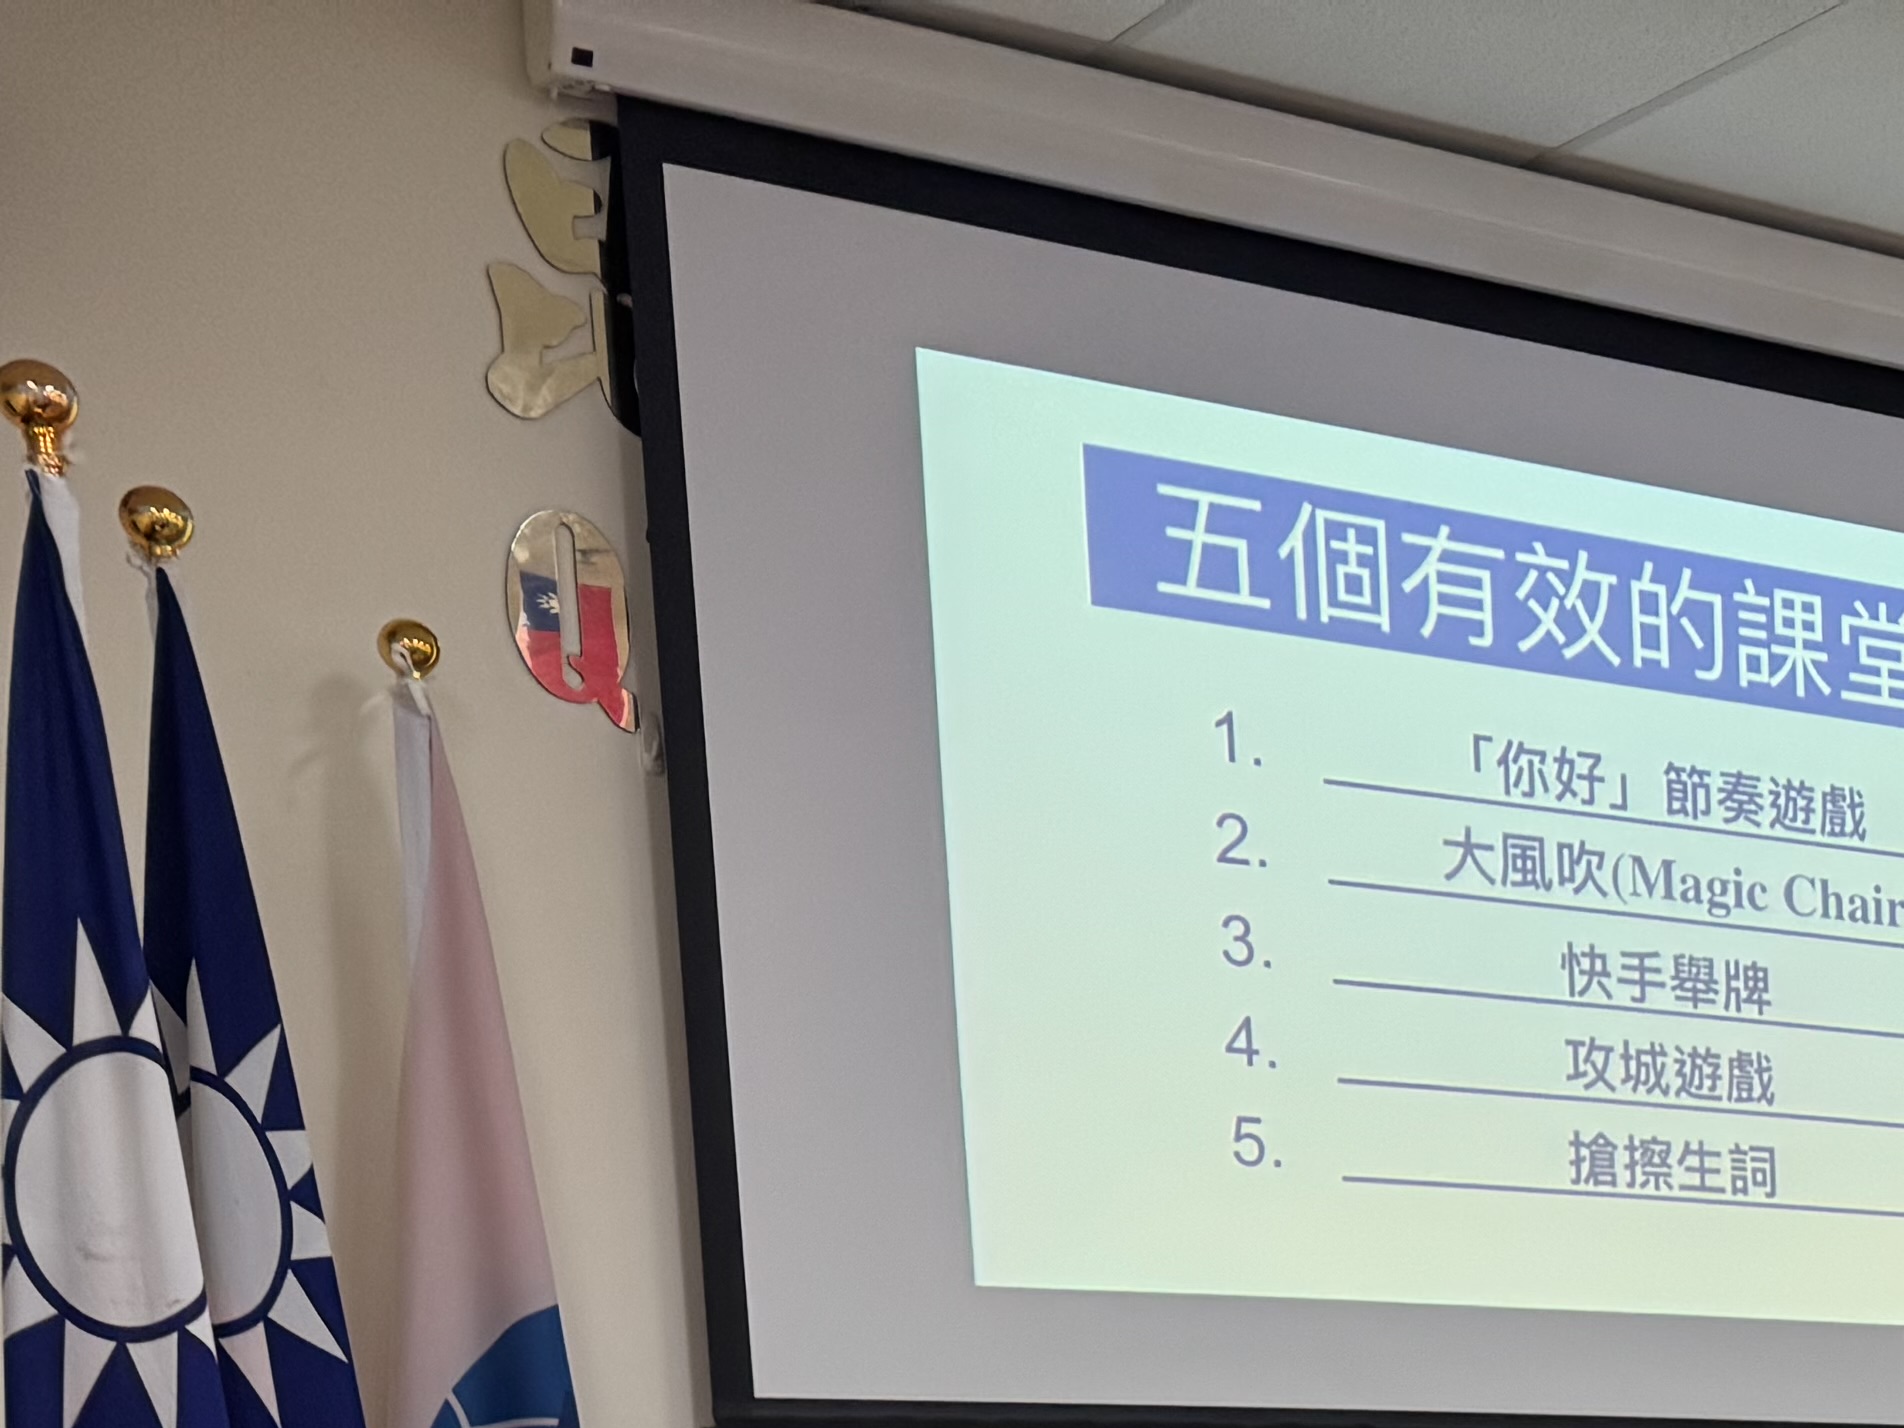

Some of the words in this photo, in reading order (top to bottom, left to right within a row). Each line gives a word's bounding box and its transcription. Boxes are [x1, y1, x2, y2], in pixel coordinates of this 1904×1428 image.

[1213, 709, 1264, 768] 1.
[1471, 733, 1868, 843] 「你好」節奏遊戲
[1215, 812, 1268, 869] 2.
[1220, 913, 1273, 969] 3.
[1559, 940, 1774, 1016] 快手舉牌
[1224, 1015, 1278, 1070] 4.
[1564, 1035, 1776, 1107] 攻城遊戲
[1231, 1115, 1284, 1169] 5.
[1568, 1129, 1778, 1199] 搶擦生詞
